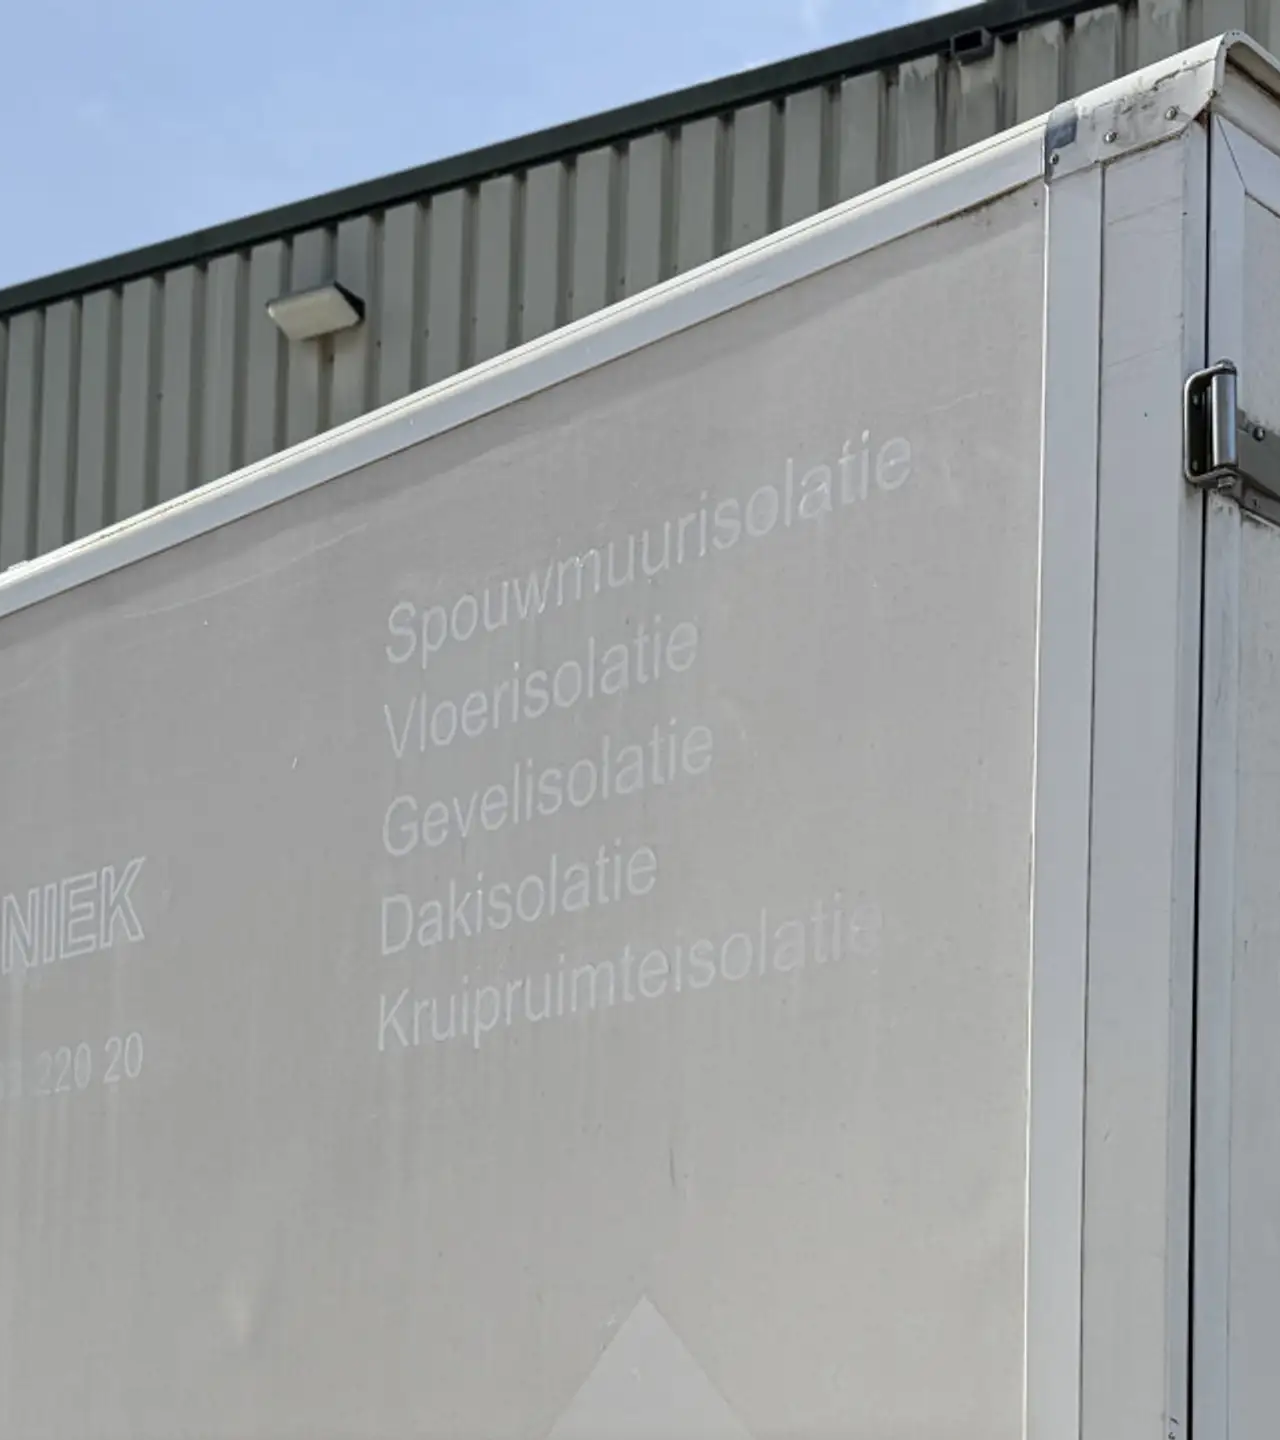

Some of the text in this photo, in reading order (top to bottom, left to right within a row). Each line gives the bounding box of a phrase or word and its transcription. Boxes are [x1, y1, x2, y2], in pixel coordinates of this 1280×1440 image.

[386, 429, 913, 669] Spouwmuurisolatie
[382, 615, 700, 760] Vloerisolatie
[381, 717, 714, 857] Gevelisolatie
[379, 838, 658, 956] Dakisolatie
[377, 892, 883, 1052] Kruipruimteisolatie
[103, 1031, 144, 1085] 20
